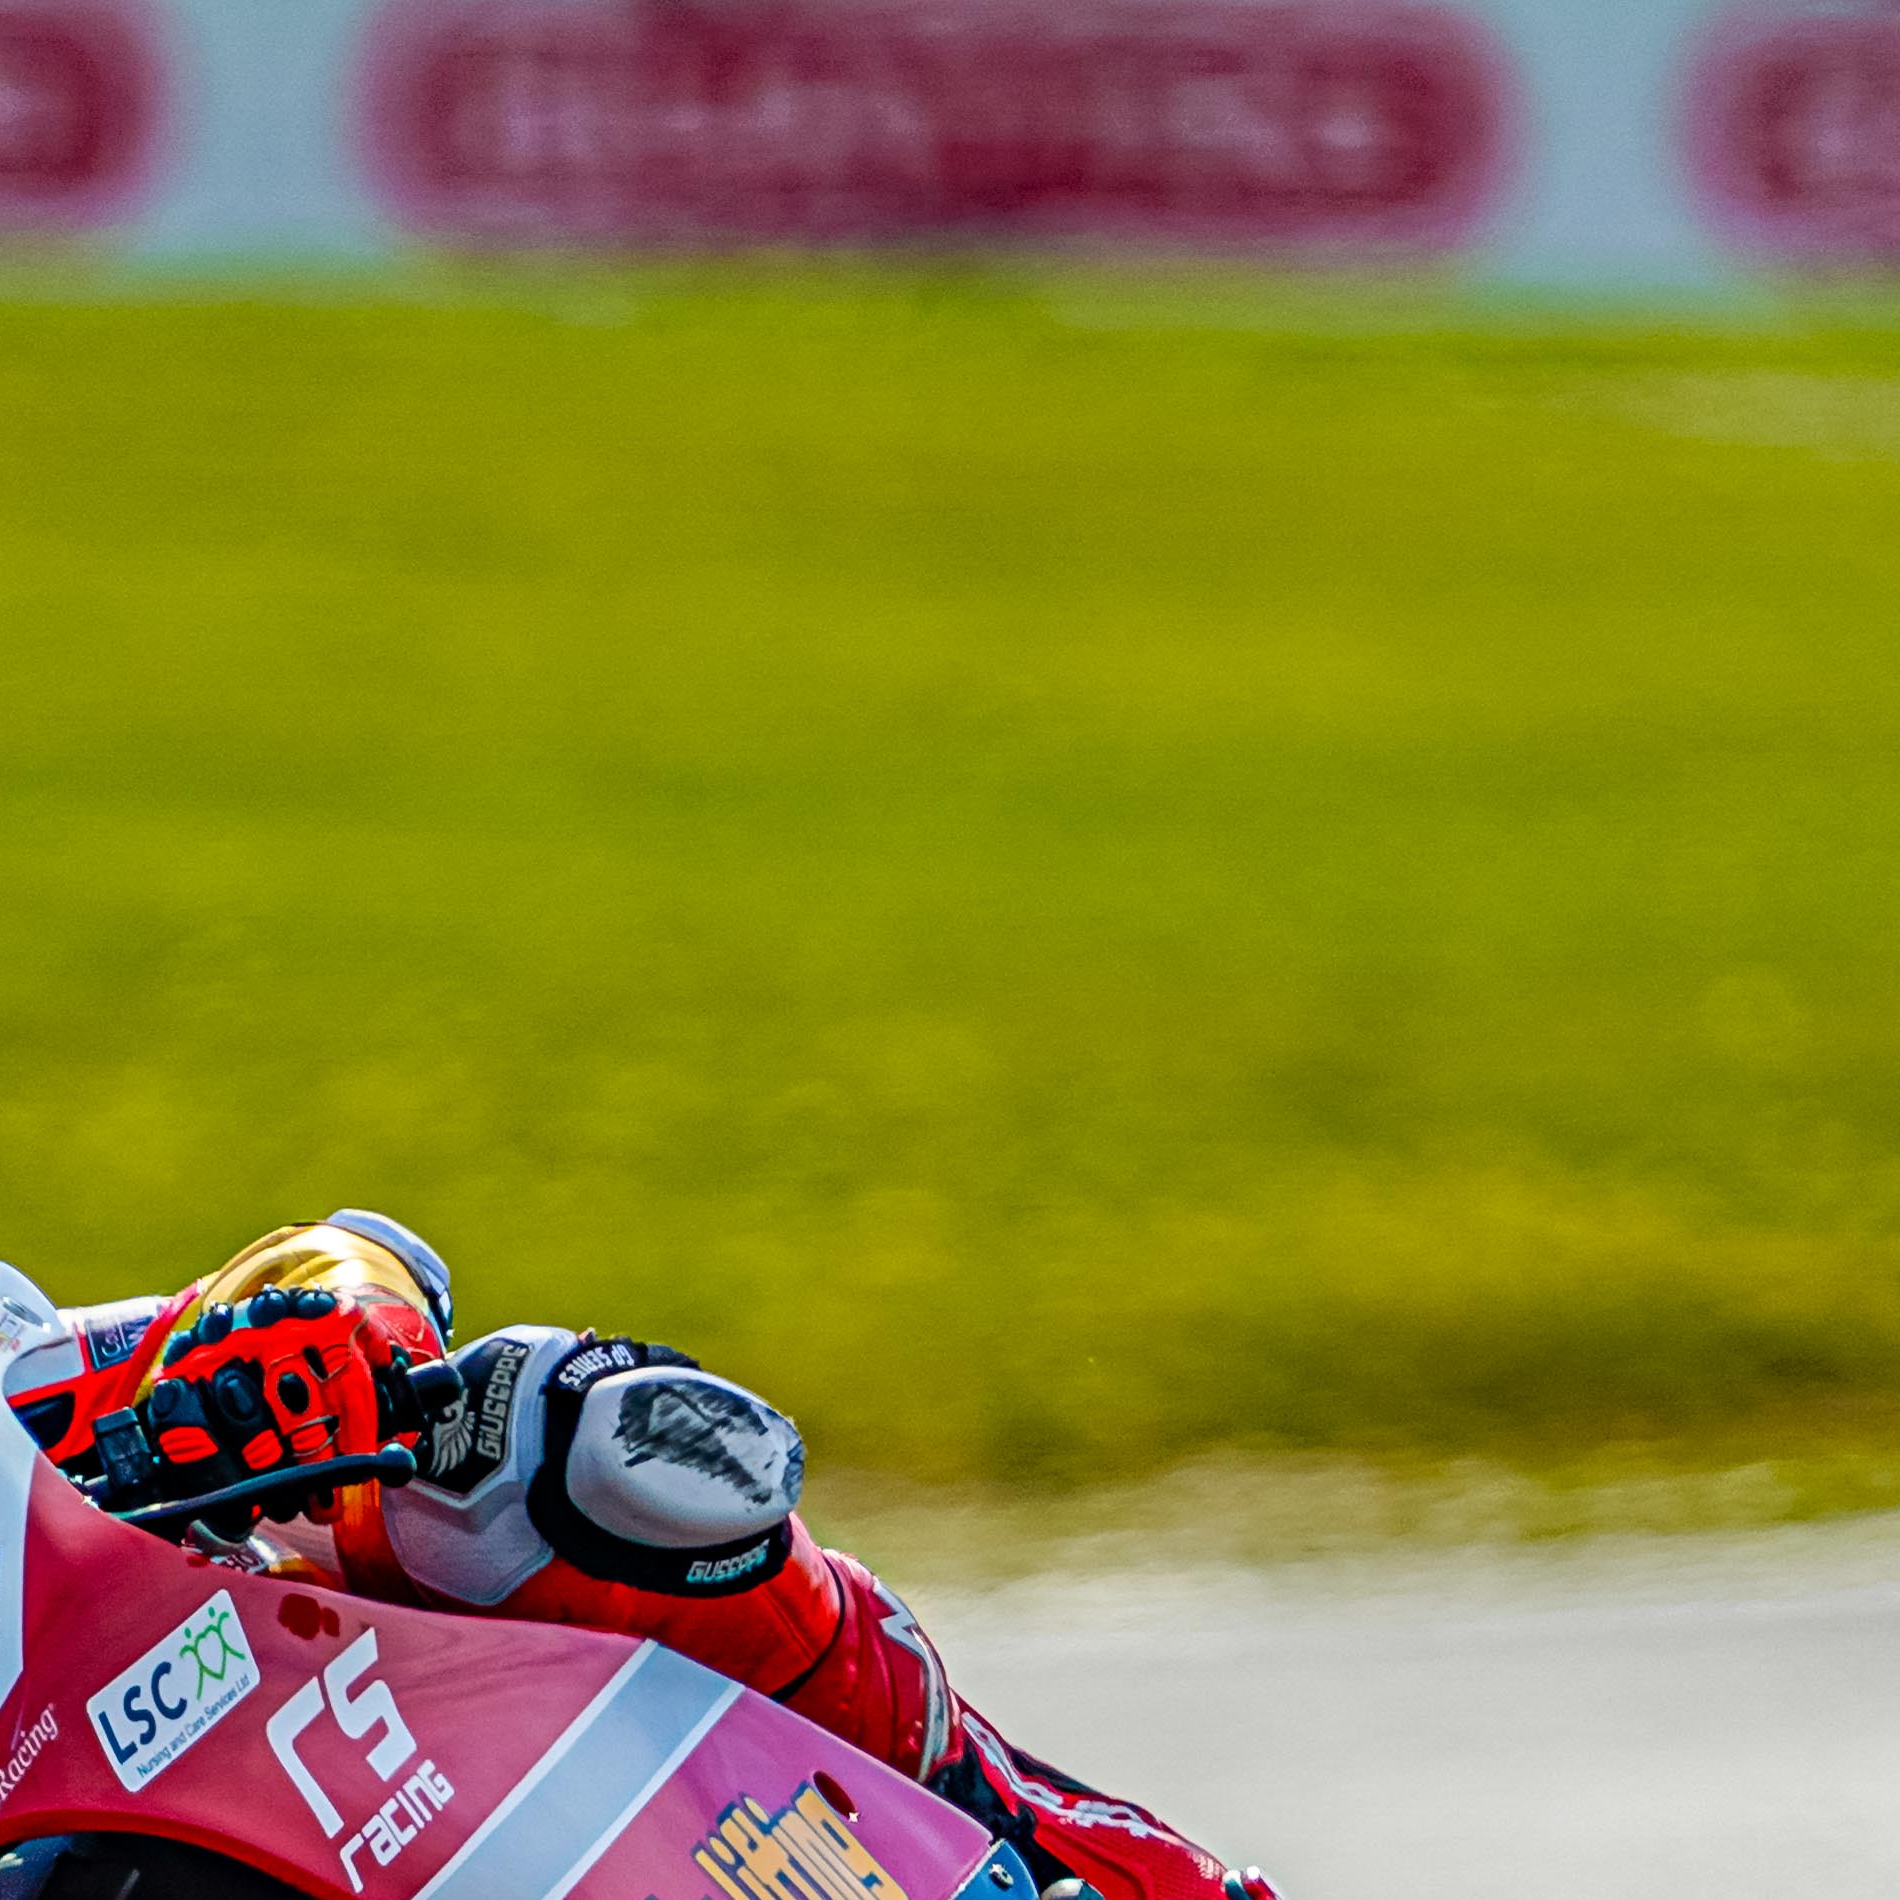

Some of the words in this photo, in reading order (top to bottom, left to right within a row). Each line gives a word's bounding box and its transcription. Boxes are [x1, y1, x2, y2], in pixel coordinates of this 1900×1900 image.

[98, 1661, 188, 1765] LSC
[136, 1746, 173, 1779] Nursing
[170, 1732, 189, 1753] and
[185, 1712, 207, 1740] Care
[204, 1688, 238, 1720] Services
[236, 1674, 252, 1692] Ltd
